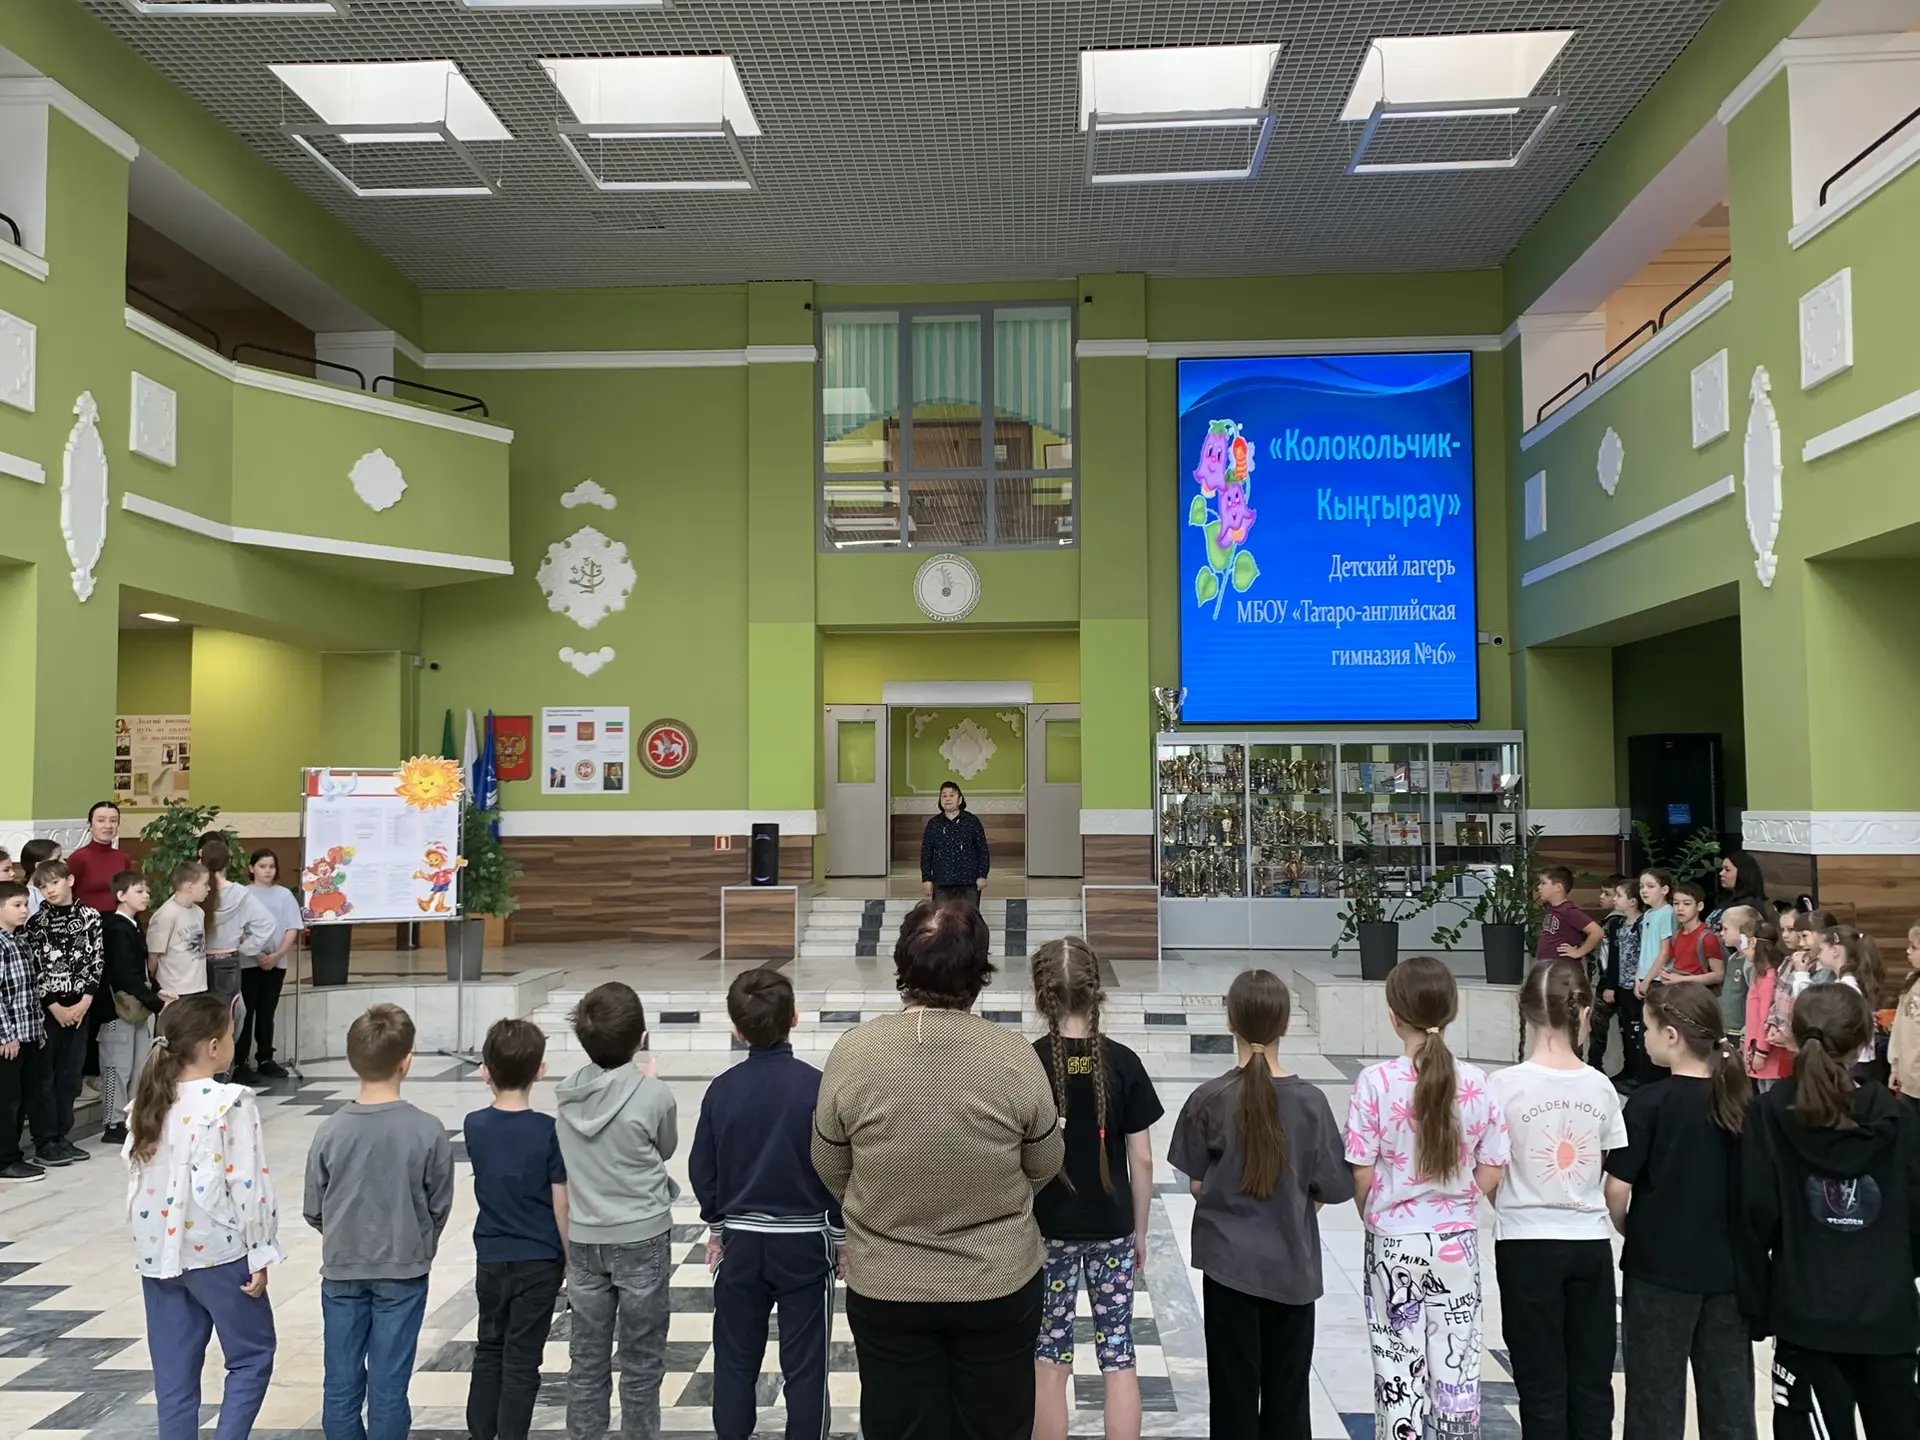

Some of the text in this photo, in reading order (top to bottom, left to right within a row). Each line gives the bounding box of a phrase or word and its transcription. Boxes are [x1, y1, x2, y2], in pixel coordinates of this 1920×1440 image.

[1269, 428, 1461, 461] «Колокольчик-
[1317, 487, 1461, 528] Кыңгырау»
[1328, 554, 1456, 583] Детский лагерь
[1236, 598, 1456, 629] МБОУ «Татаро-английская
[1331, 641, 1456, 666] гимназия №16»
[1521, 1100, 1607, 1123] GOLDEN HOUR
[1383, 1237, 1403, 1248] OUT
[1385, 1250, 1430, 1267] OF MIND
[1436, 1379, 1474, 1395] QUEEN
